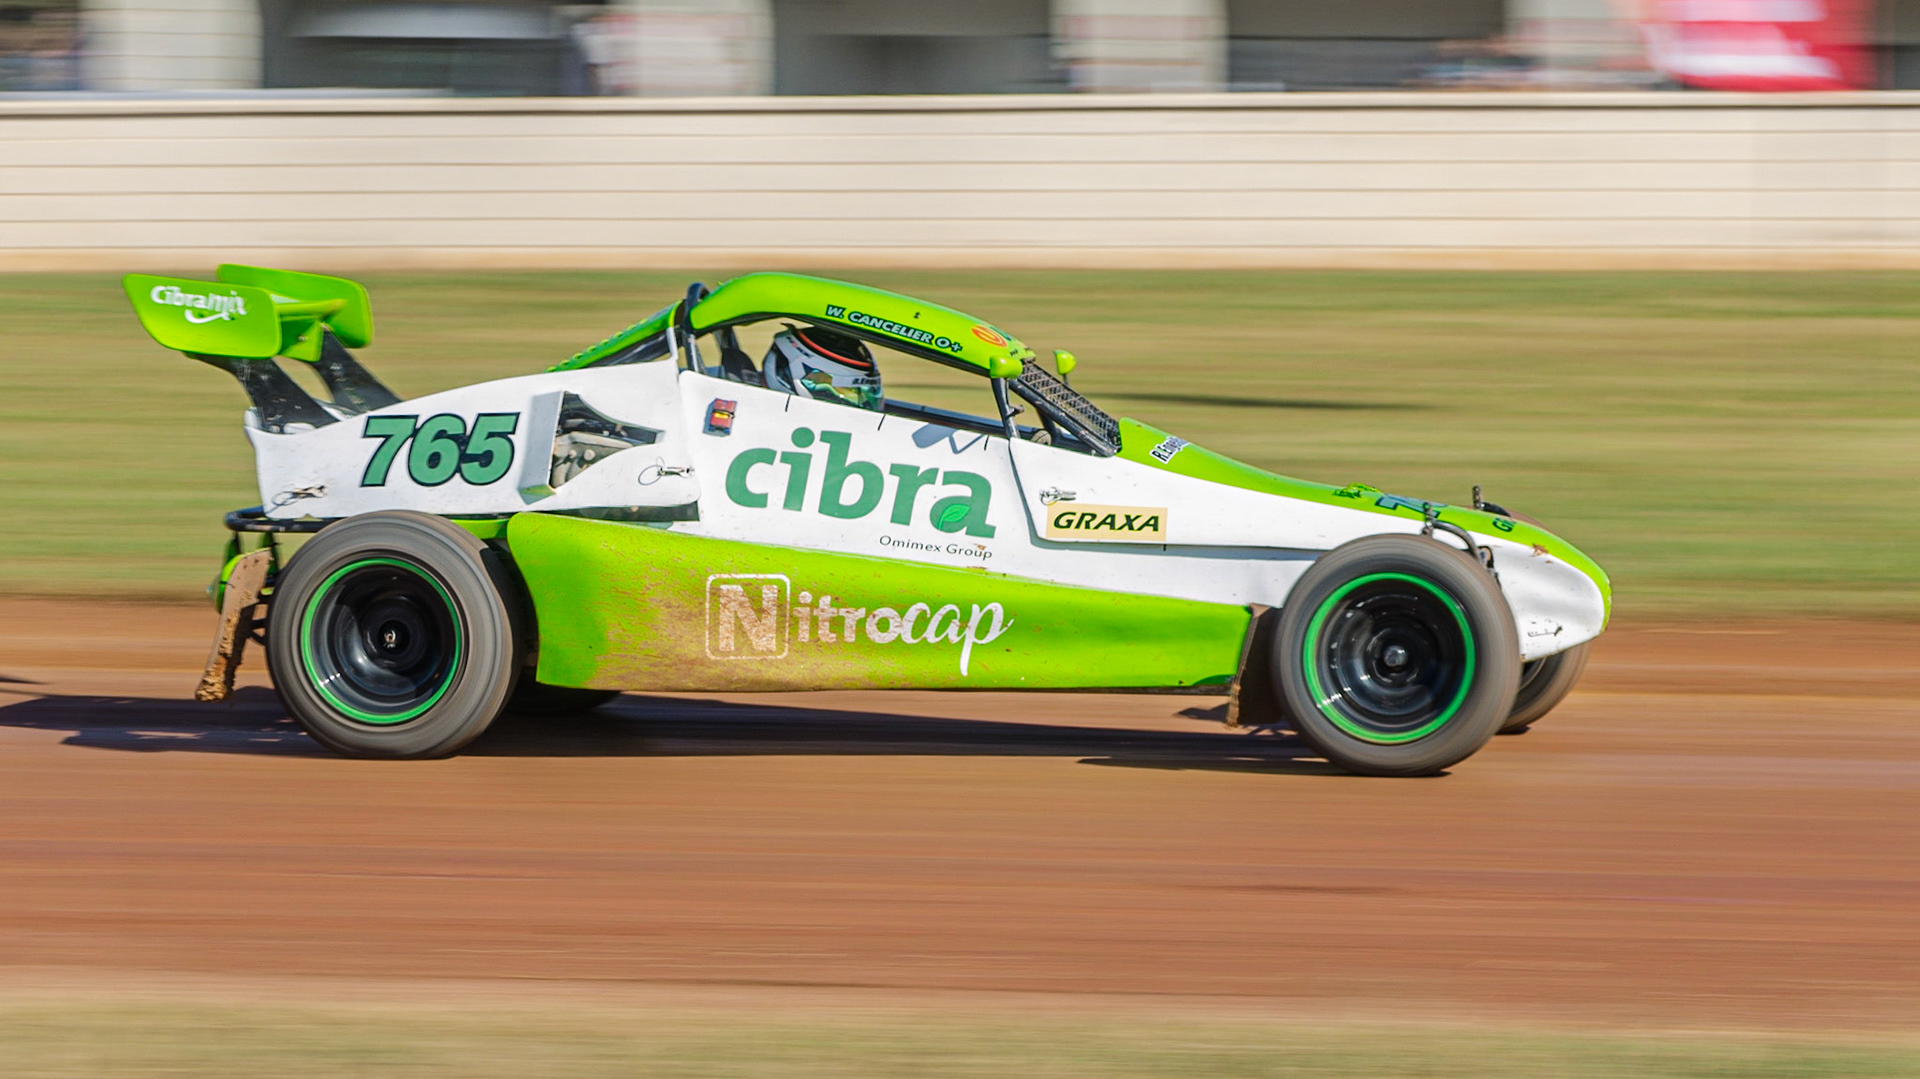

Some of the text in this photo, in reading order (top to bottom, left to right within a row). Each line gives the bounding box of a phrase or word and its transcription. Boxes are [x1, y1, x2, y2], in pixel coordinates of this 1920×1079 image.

[826, 305, 844, 319] W.
[849, 311, 933, 345] CANCELIER
[361, 412, 521, 487] 765
[725, 427, 996, 539] cibra
[879, 535, 993, 561] Omimex Group
[1053, 511, 1160, 532] GRAXA
[718, 584, 1015, 677] Nitrocap
